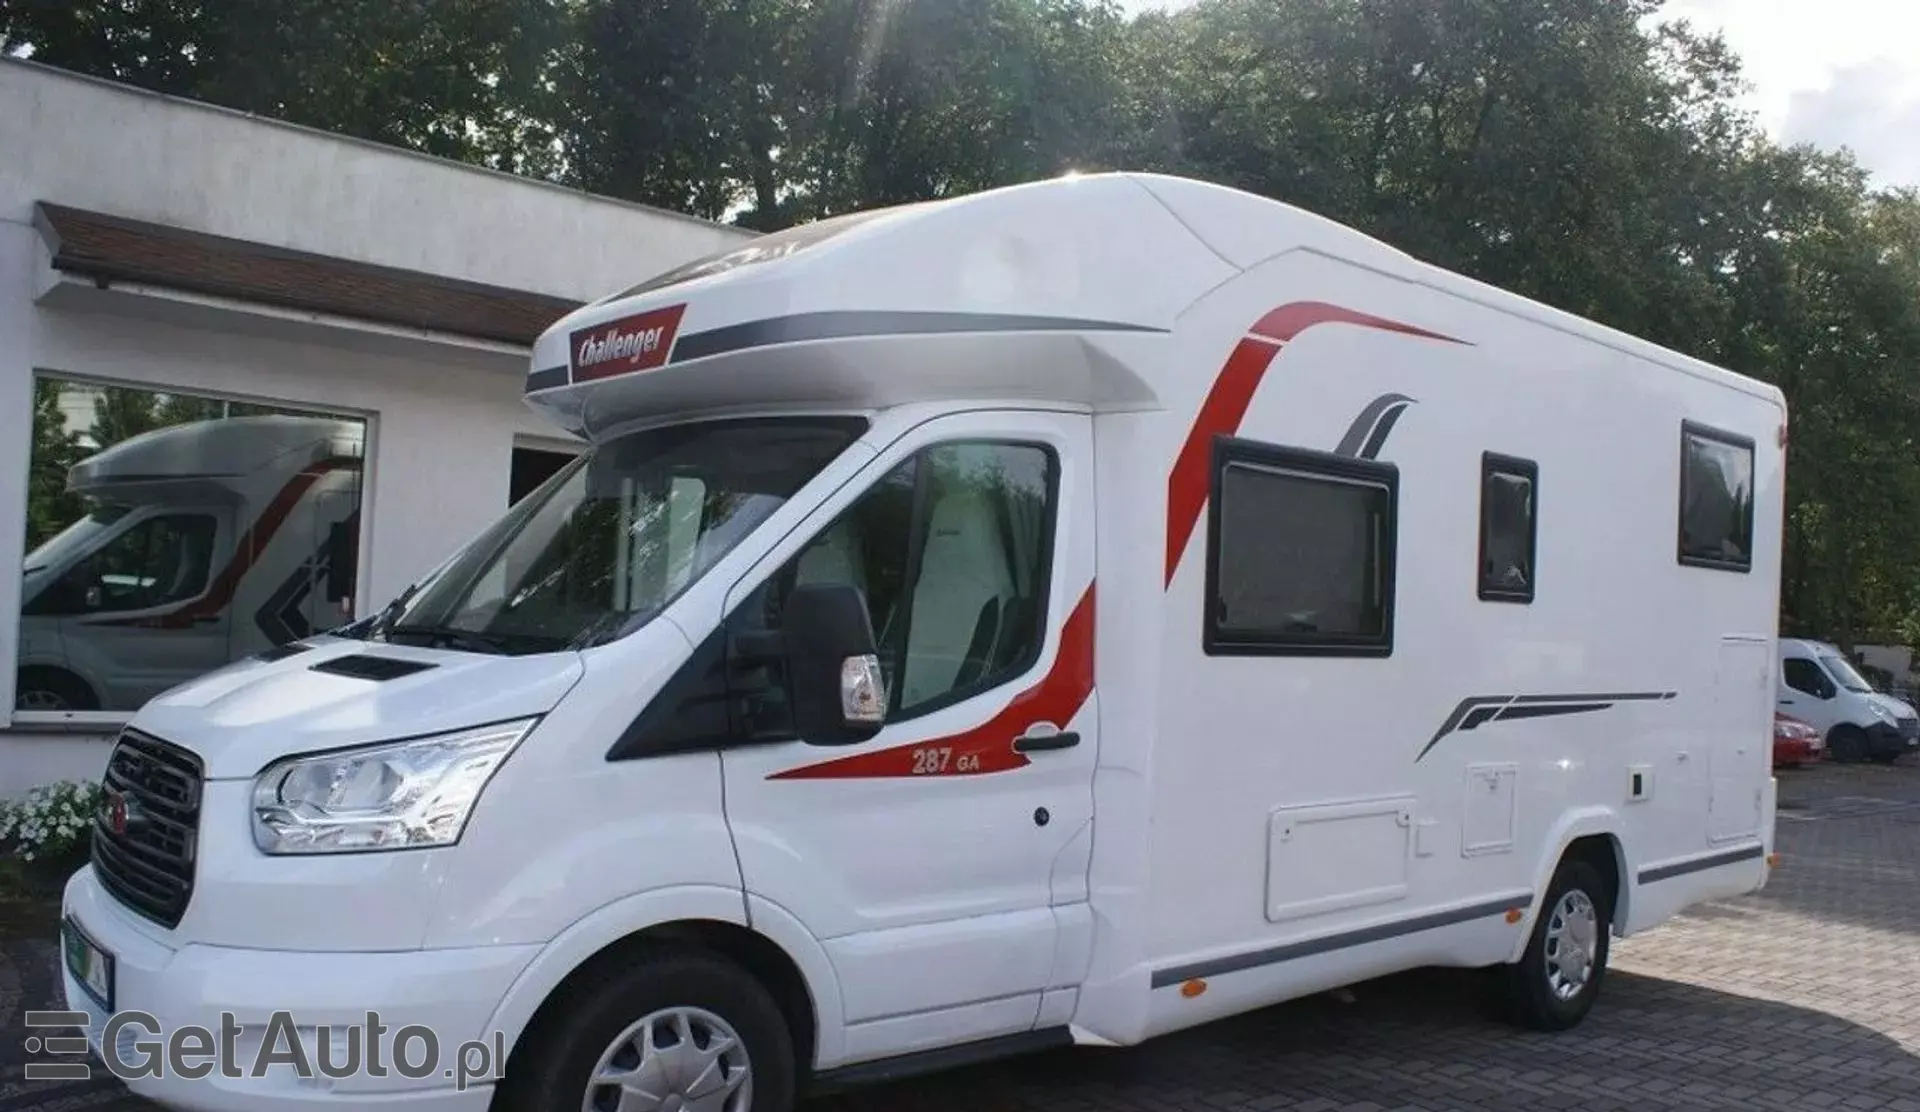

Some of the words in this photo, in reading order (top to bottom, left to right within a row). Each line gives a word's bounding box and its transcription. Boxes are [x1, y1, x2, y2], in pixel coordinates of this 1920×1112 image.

[578, 325, 664, 367] Challenger
[911, 747, 953, 774] 287
[956, 755, 980, 772] GA
